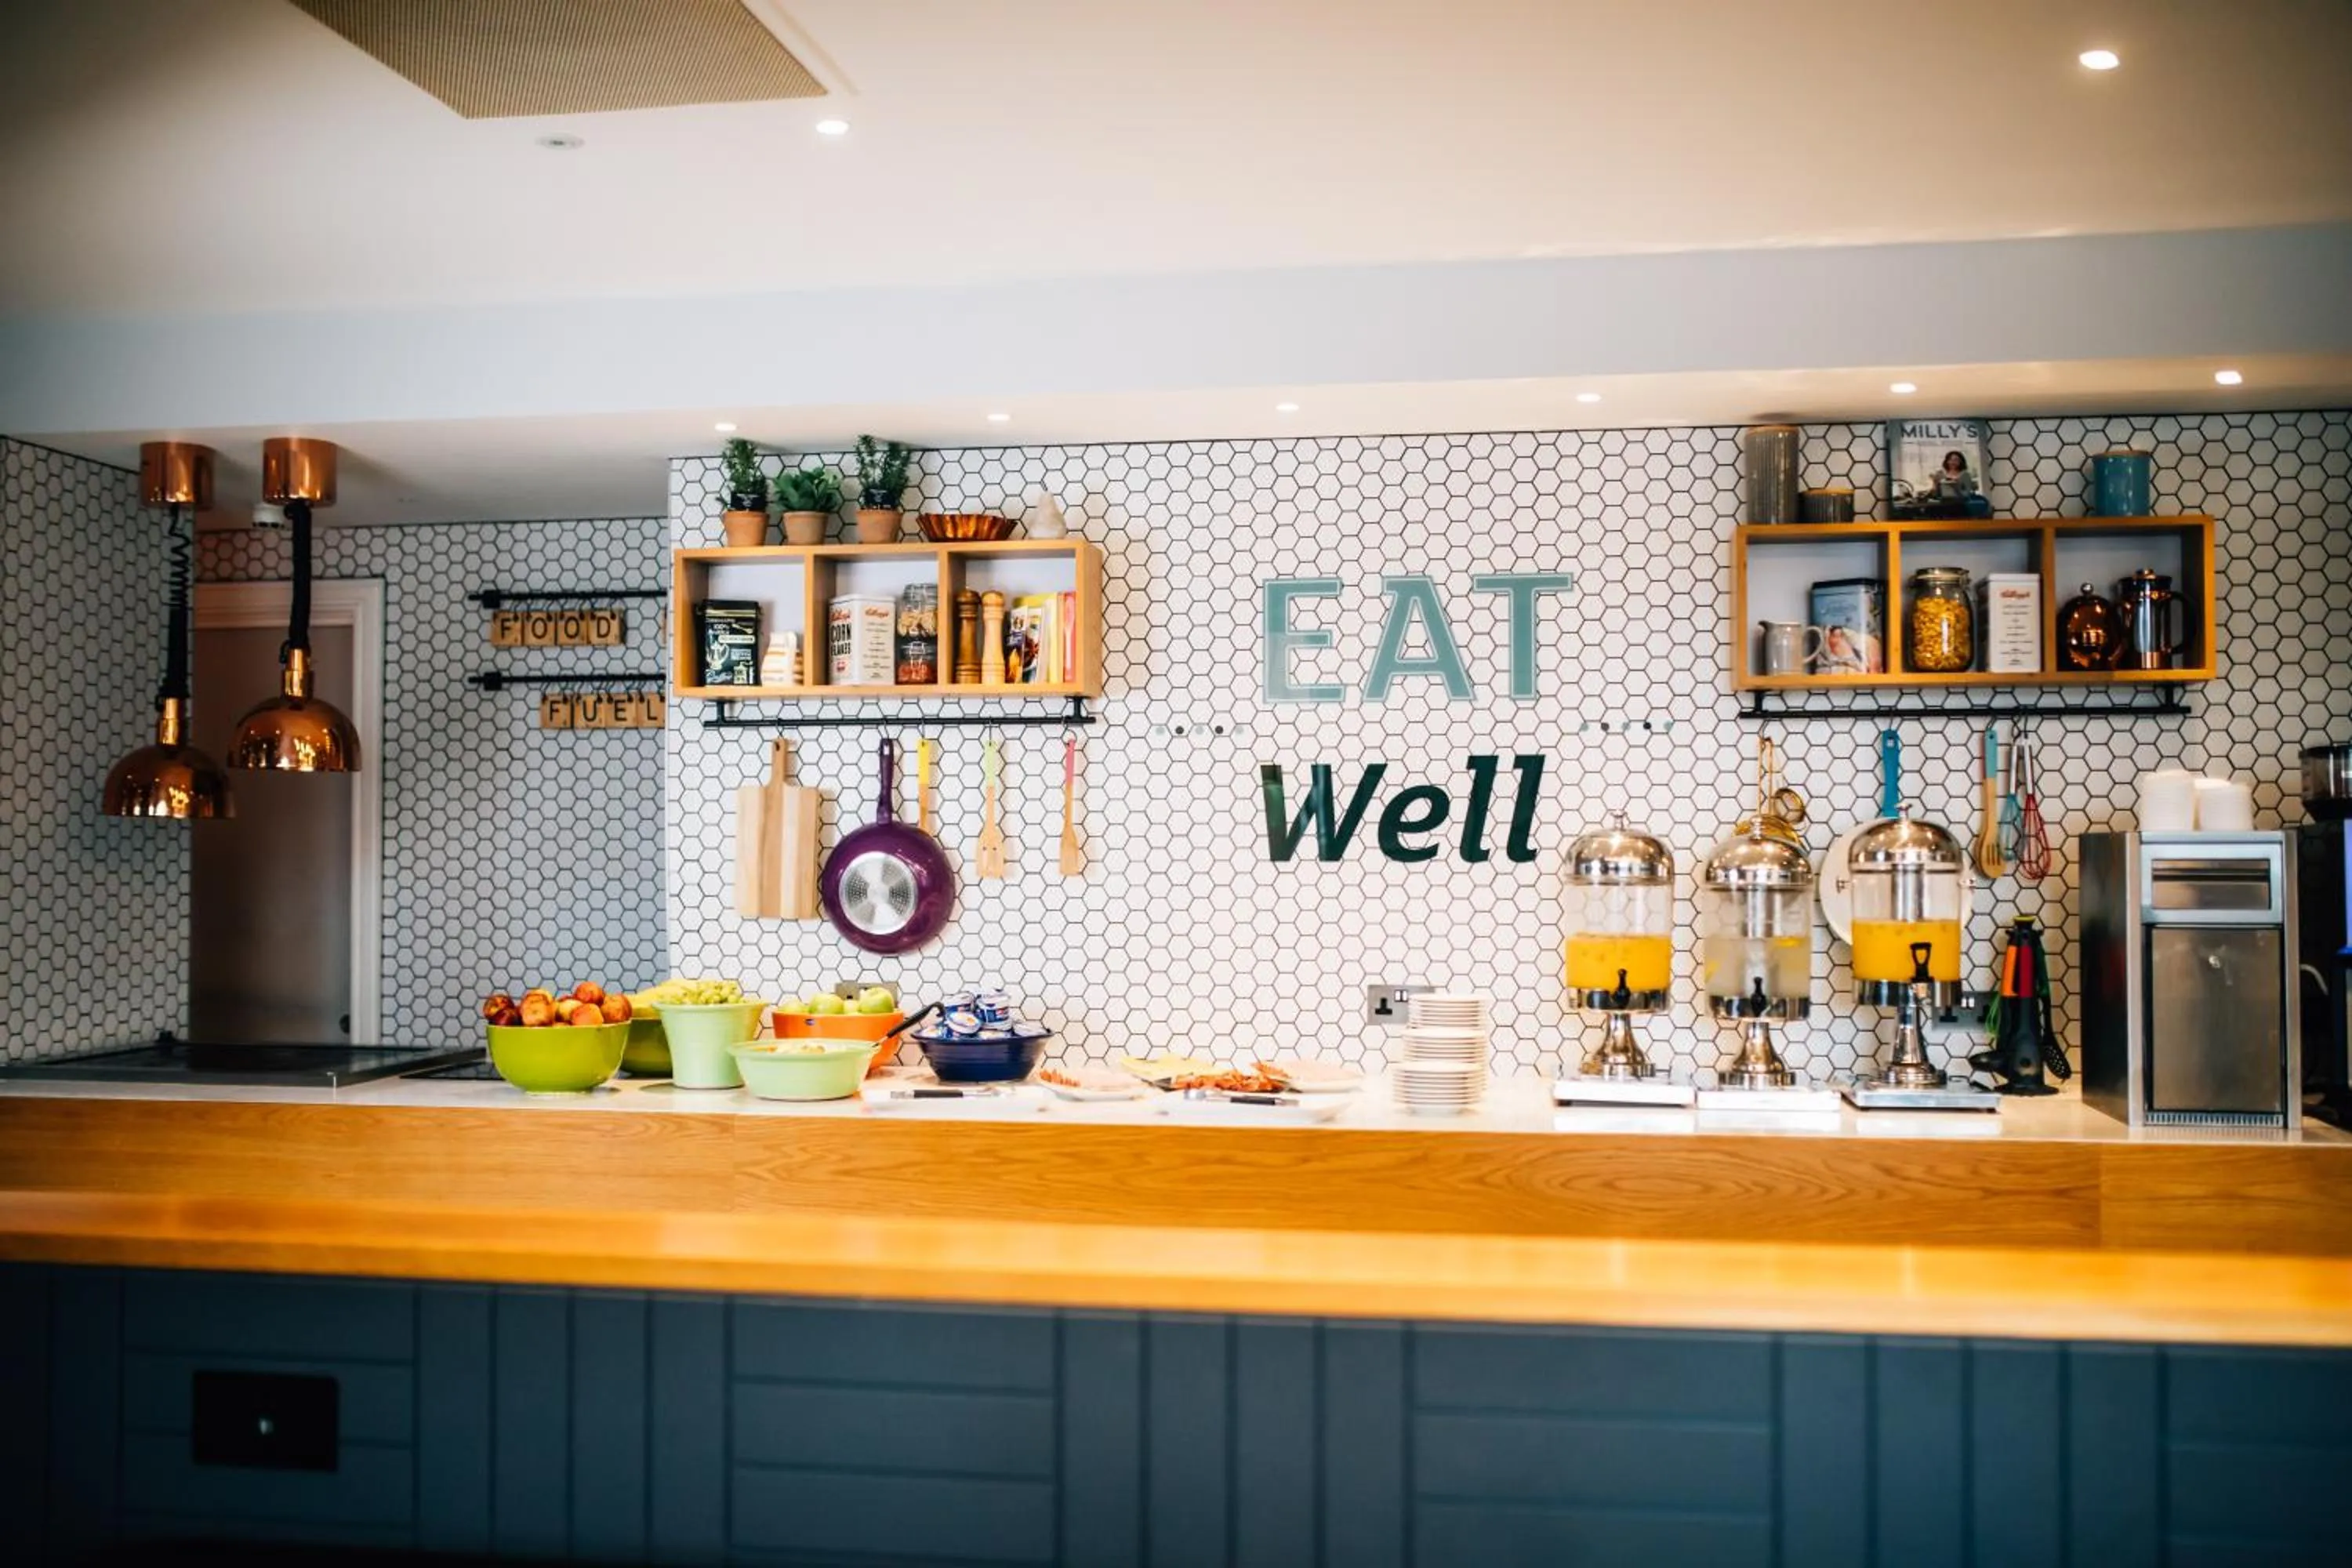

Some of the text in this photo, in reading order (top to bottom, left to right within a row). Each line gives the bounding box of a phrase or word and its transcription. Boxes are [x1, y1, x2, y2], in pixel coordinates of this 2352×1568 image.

[1900, 423, 1978, 439] MILLY'S
[499, 615, 612, 641] FOOD
[829, 622, 852, 644] CORN
[1263, 572, 1573, 702] EAT
[548, 698, 659, 723] FUEL
[1260, 754, 1546, 863] Well
